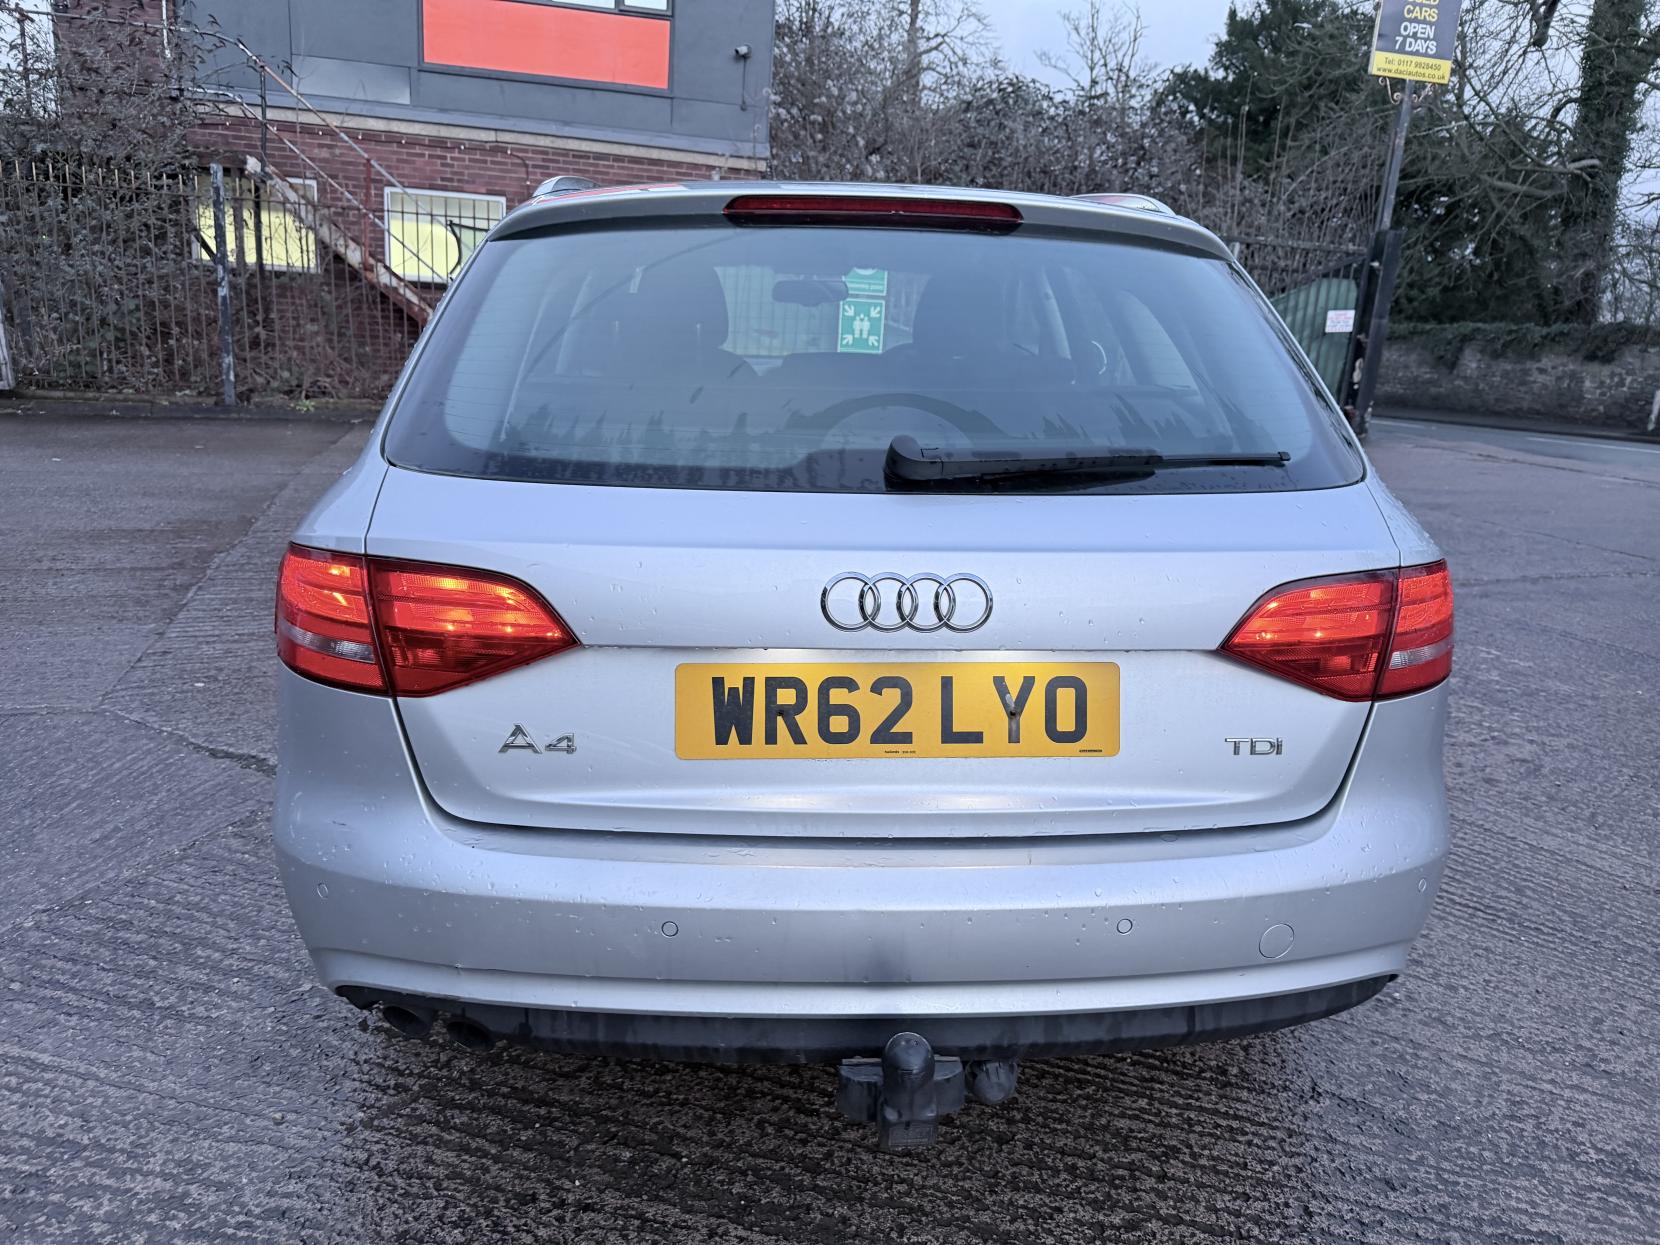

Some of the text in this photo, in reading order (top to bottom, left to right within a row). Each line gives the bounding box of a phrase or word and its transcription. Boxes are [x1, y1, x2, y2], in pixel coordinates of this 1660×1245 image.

[1404, 4, 1438, 22] CARS
[1400, 21, 1435, 39] OPEN
[1395, 36, 1437, 54] 7 DAYS
[1397, 59, 1413, 67] 0117
[711, 675, 1088, 745] WR62 LYO
[498, 723, 577, 754] A4
